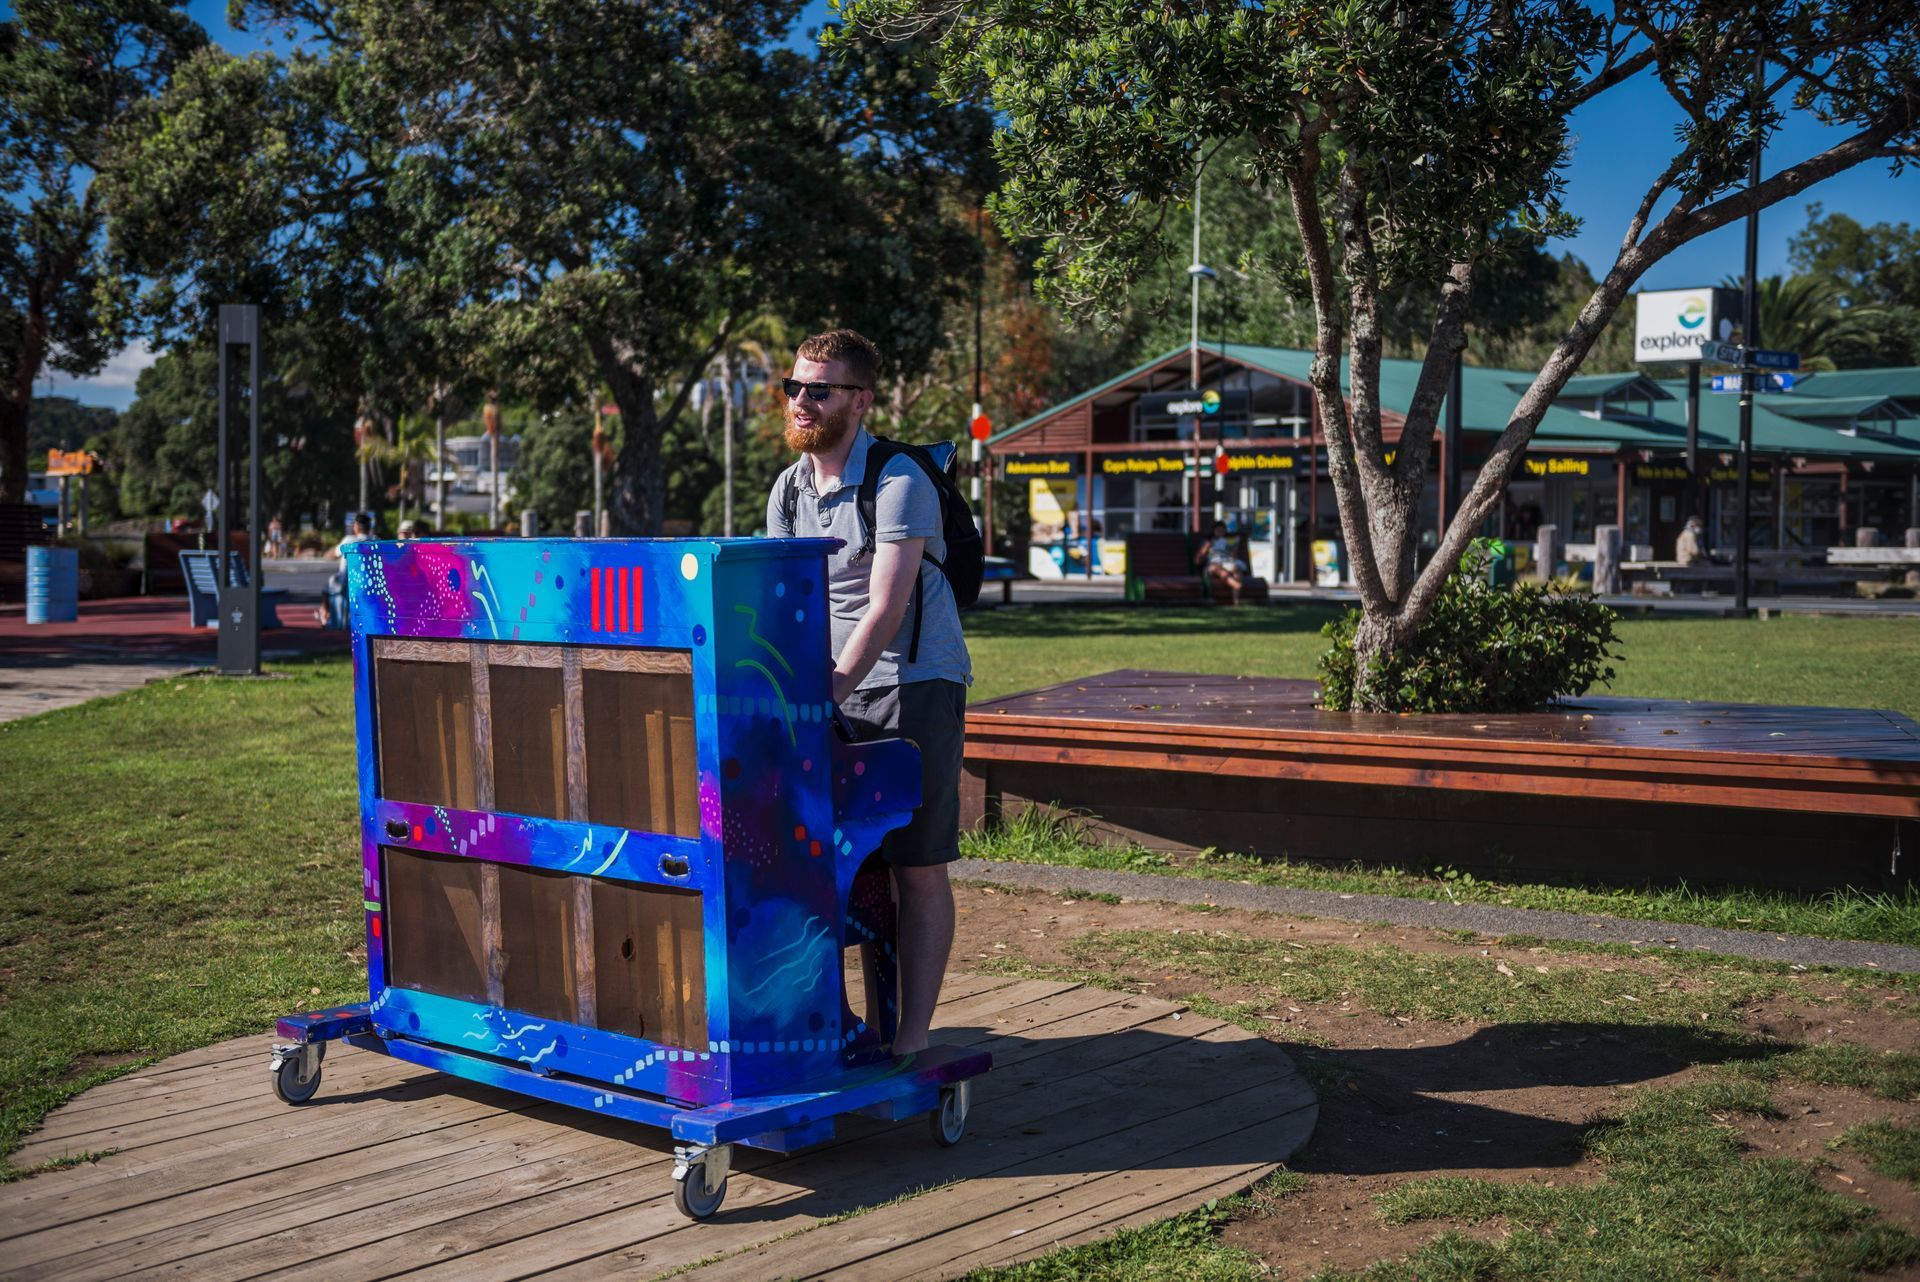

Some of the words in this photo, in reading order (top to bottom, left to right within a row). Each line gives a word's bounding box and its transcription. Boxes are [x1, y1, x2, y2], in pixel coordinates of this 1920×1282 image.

[1641, 332, 1705, 352] explore
[1167, 399, 1202, 416] explore
[1103, 459, 1126, 474] Cape
[1158, 457, 1185, 472] Tours
[1256, 454, 1293, 469] Cruises
[1548, 458, 1589, 475] Sailing
